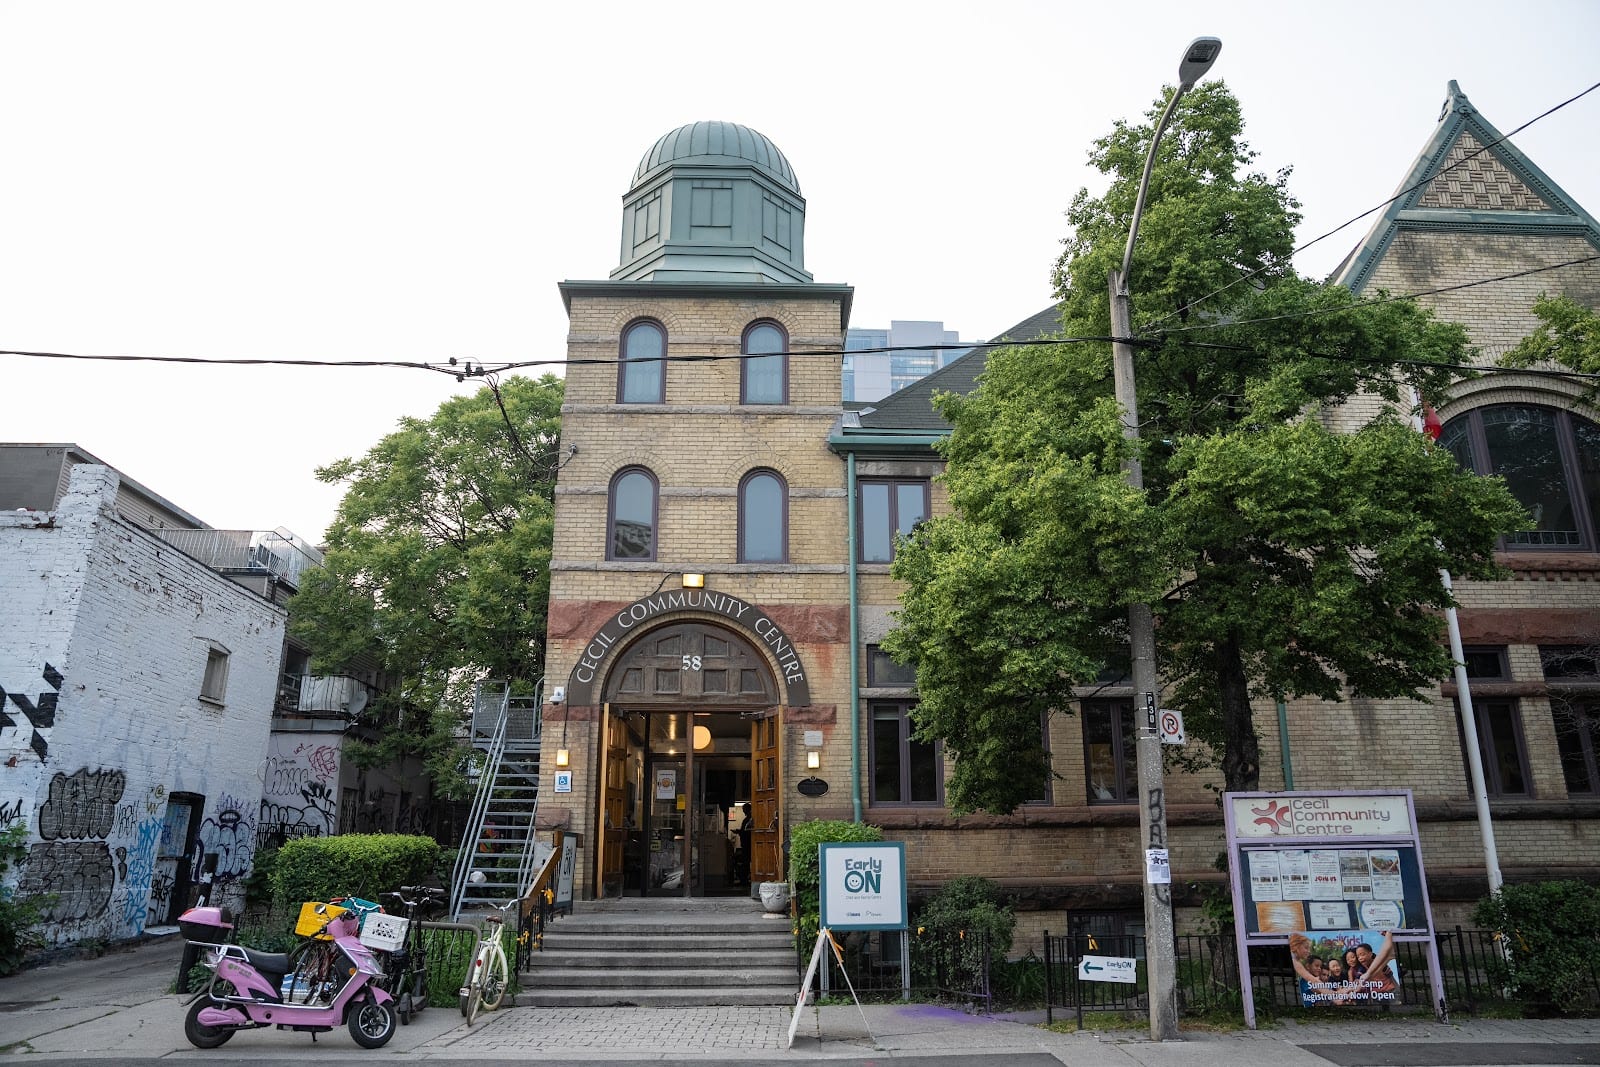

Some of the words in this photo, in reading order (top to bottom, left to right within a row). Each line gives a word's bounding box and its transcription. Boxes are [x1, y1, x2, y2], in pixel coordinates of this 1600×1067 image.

[576, 632, 616, 683] CECIL
[617, 591, 750, 628] COMMUNITY
[754, 617, 804, 685] CENTRE
[681, 655, 702, 671] 58
[1293, 799, 1330, 810] Cecil
[1294, 809, 1390, 822] Community
[1295, 823, 1353, 835] Centre
[844, 857, 882, 873] Early
[844, 870, 882, 893] ON
[1307, 981, 1341, 990] Summer
[1342, 980, 1359, 990] Day
[1360, 980, 1383, 991] Camp
[1303, 992, 1349, 1003] Registration
[1350, 992, 1370, 1000] Now
[1371, 991, 1395, 1001] Open
